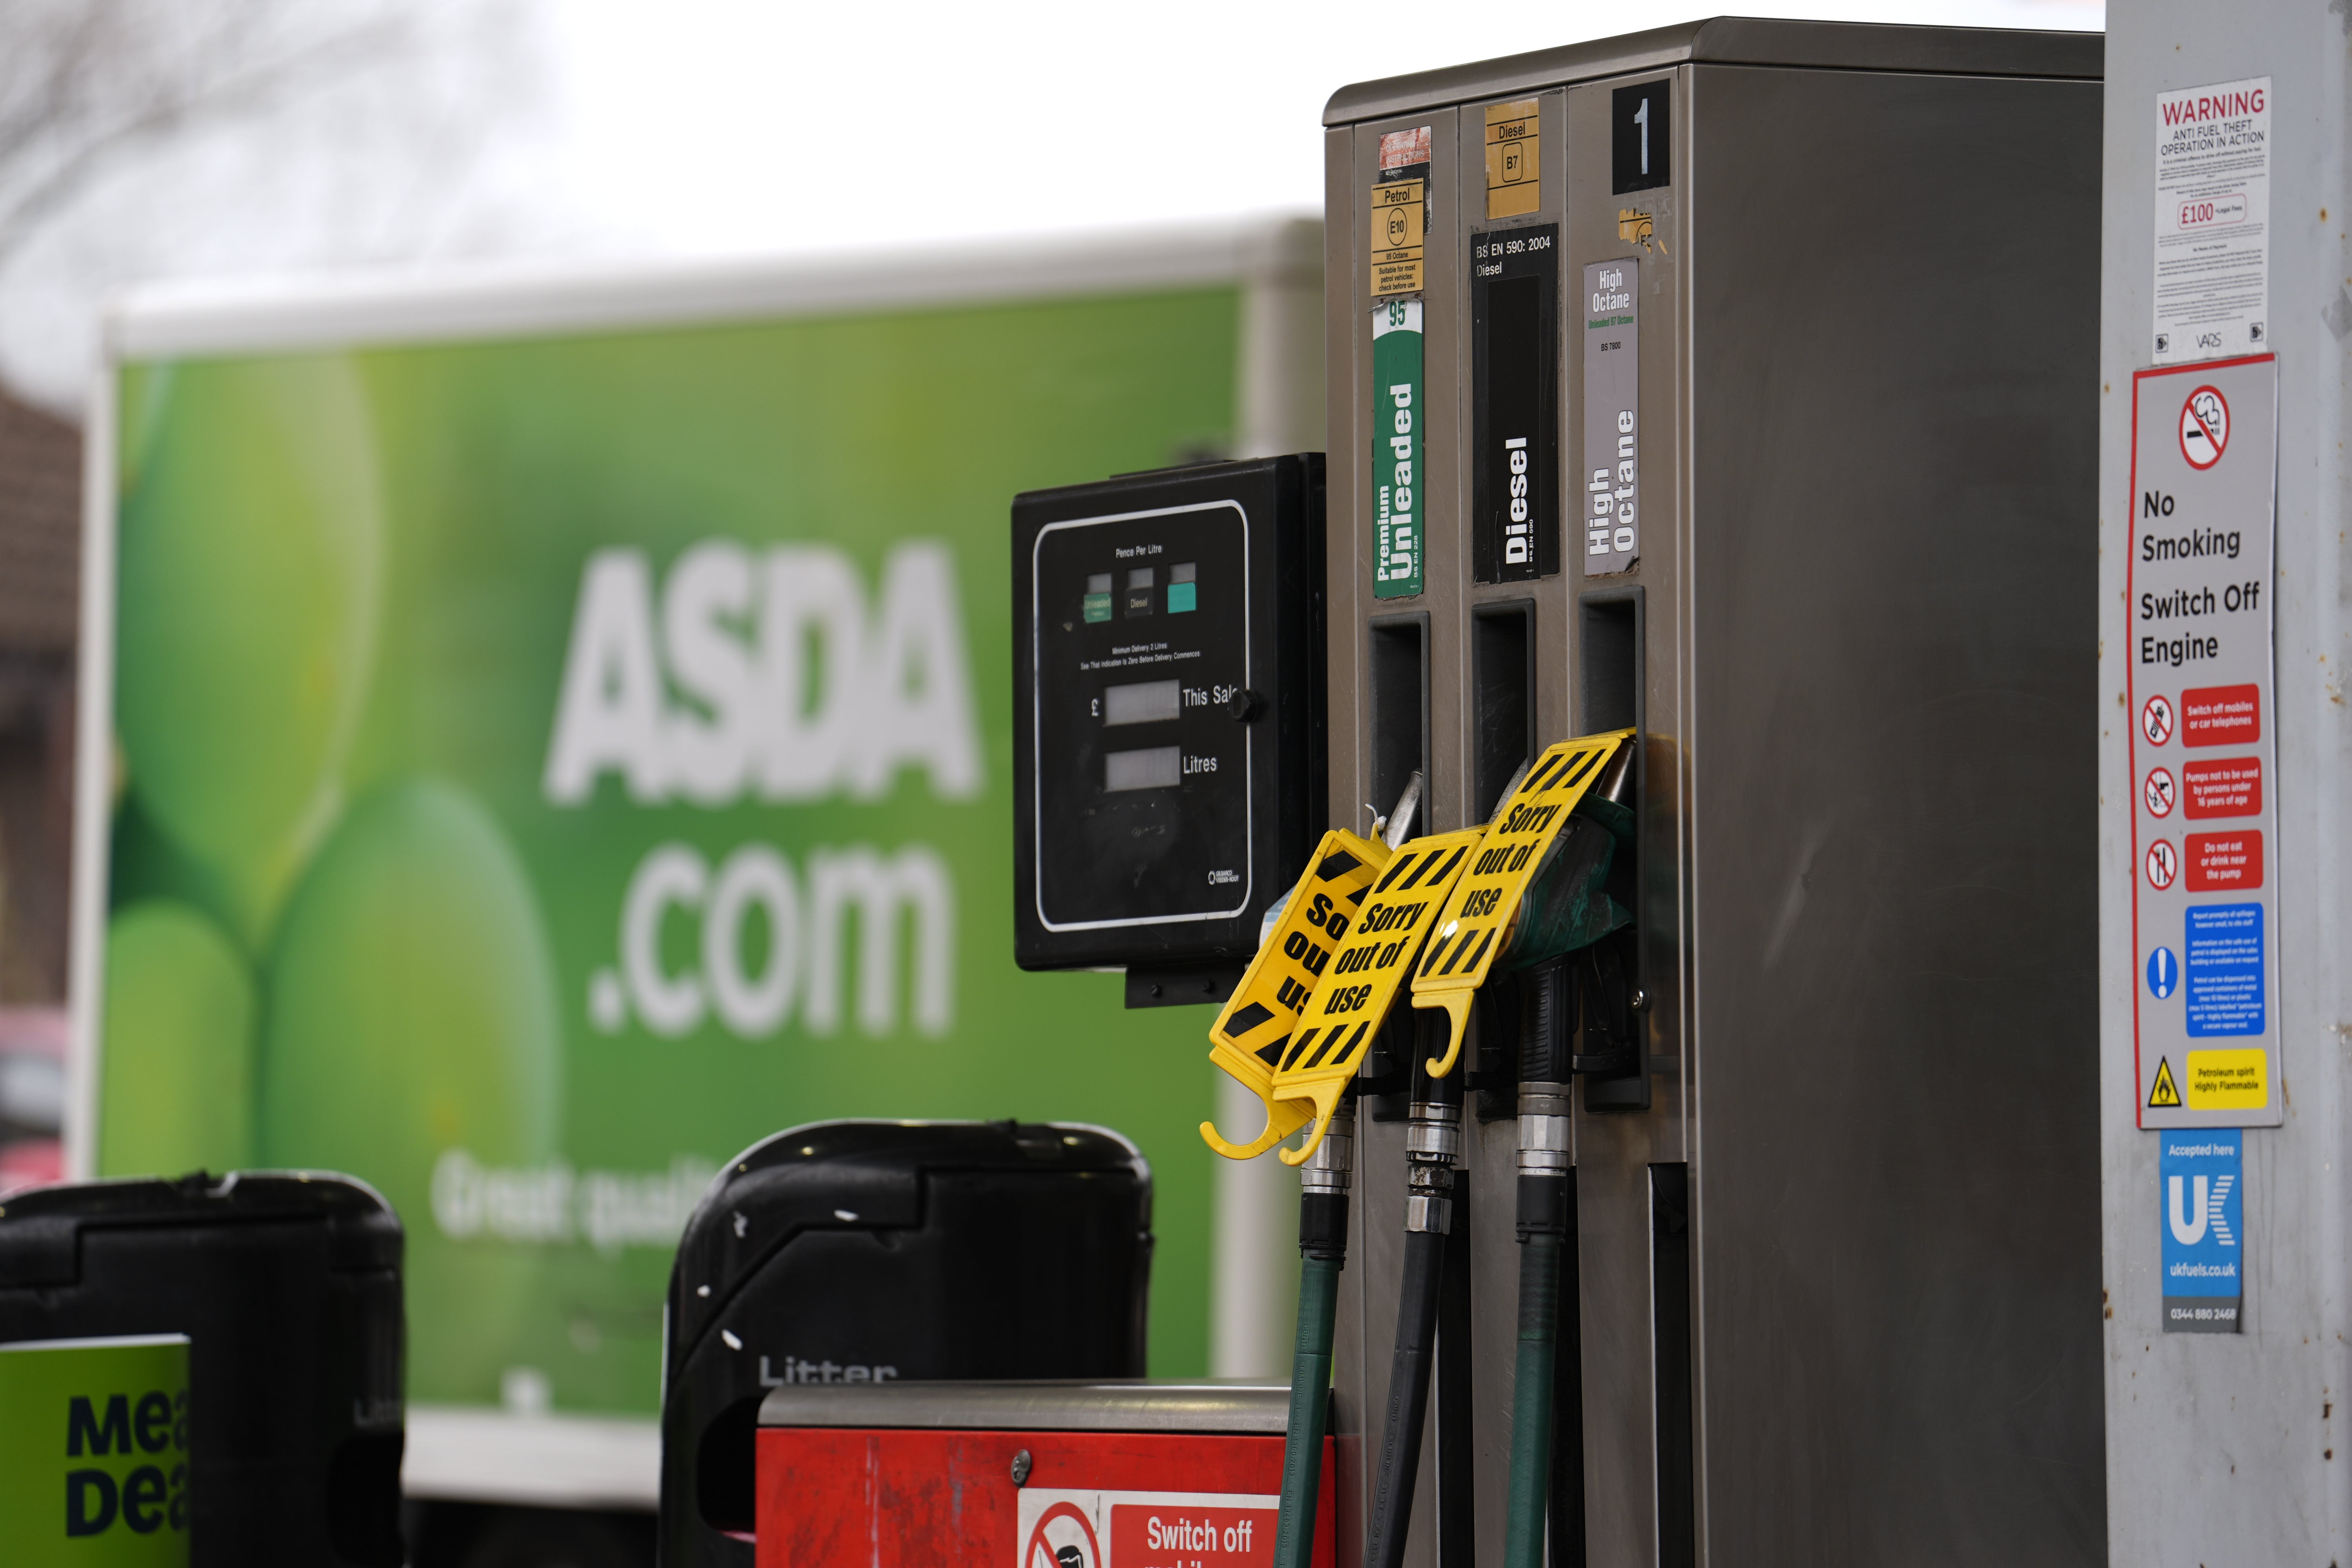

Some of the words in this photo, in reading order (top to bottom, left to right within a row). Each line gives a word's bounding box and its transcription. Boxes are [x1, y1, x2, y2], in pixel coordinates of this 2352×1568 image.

[2162, 88, 2264, 126] WARNING
[1499, 122, 1525, 140] Diesel
[1634, 98, 1648, 175] 1
[2173, 128, 2194, 141] ANTI
[2198, 124, 2220, 137] FUEL
[2223, 119, 2252, 133] THEFT
[2161, 138, 2213, 156] OPERATION
[2216, 136, 2225, 148] IN
[2229, 130, 2264, 146] ACTION
[1386, 150, 1424, 164] INSTRUCTIONS
[1507, 155, 1518, 170] B7
[1385, 187, 1410, 203] Petrol
[2182, 203, 2213, 224] £100
[1390, 220, 1404, 234] E10
[1477, 245, 1488, 258] BS
[1492, 243, 1503, 256] EN
[1506, 240, 1525, 254] 590:
[1528, 236, 1550, 251] 2004
[1379, 265, 1396, 274] Suitable
[1477, 261, 1502, 277] Diesel
[1379, 283, 1392, 292] check
[1381, 276, 1393, 284] petrol
[1599, 268, 1622, 292] High
[1593, 292, 1629, 313] Octane
[1389, 300, 1405, 326] 95
[1589, 317, 1610, 329] Unleaded
[1610, 316, 1616, 326] 97
[1617, 316, 1633, 325] Octane
[1609, 341, 1621, 350] 7800
[1390, 383, 1412, 580] Unleaded
[1613, 410, 1634, 553] Octane
[1505, 437, 1527, 564] Diesel
[2144, 491, 2174, 518] No
[1589, 468, 1614, 556] High
[1377, 485, 1389, 581] Premium
[1529, 536, 1534, 548] EN
[1116, 548, 1134, 558] Pence
[1136, 546, 1146, 556] Per
[1148, 544, 1161, 554] Litre
[2142, 527, 2240, 562] Smoking
[1414, 552, 1418, 564] EN
[1414, 566, 1418, 577] BS
[1085, 598, 1111, 609] Unleaded
[1131, 597, 1147, 608] Diesel
[2141, 586, 2215, 620] Switch
[2224, 581, 2260, 612] Off
[1131, 644, 1149, 653] Delivery
[2142, 633, 2218, 667] Engine
[1090, 661, 1100, 669] That
[1101, 659, 1121, 668] Indication
[1155, 653, 1172, 662] Delivery
[1173, 651, 1200, 660] Commences
[541, 535, 986, 808] ASDA
[1183, 688, 1207, 707] This
[1091, 699, 1099, 717] £
[2187, 703, 2212, 717] Switch
[2212, 702, 2224, 714] off
[2224, 701, 2253, 713] mobiles
[2189, 720, 2198, 730] or
[2199, 719, 2210, 729] car
[2212, 715, 2252, 728] telephones
[1183, 755, 1218, 774] Litres
[2186, 771, 2209, 784] Pumps
[2210, 771, 2221, 781] not
[2222, 770, 2230, 780] to
[2231, 769, 2240, 779] be
[2241, 768, 2259, 779] used
[2193, 785, 2202, 796] by
[2203, 784, 2230, 796] persons
[2231, 782, 2252, 792] under
[2198, 797, 2206, 807] 16
[2207, 796, 2225, 808] years
[2226, 795, 2234, 804] of
[2234, 795, 2248, 806] age
[1499, 803, 1563, 835] Sorry
[2205, 842, 2216, 853] Do
[2216, 842, 2229, 852] not
[2230, 841, 2243, 851] eat
[1473, 843, 1515, 876] out
[1508, 838, 1541, 872] of
[2200, 857, 2210, 867] or
[2210, 855, 2229, 867] drink
[2230, 855, 2247, 864] near
[2206, 869, 2219, 880] the
[2220, 869, 2241, 881] pump
[1460, 887, 1502, 918] use
[1358, 901, 1430, 935] Sorry
[589, 842, 956, 1039] .com
[1284, 931, 1330, 978] ou
[1335, 943, 1380, 975] out
[1376, 936, 1411, 968] of
[1324, 984, 1372, 1015] use
[2198, 1067, 2234, 1077] Petroleum
[2236, 1066, 2255, 1078] spirit
[2194, 1081, 2217, 1093] Highly
[2219, 1080, 2259, 1090] Flammable
[2169, 1143, 2212, 1158] Accepted
[2213, 1143, 2234, 1156] here
[2168, 1175, 2235, 1246] UK
[2170, 1262, 2236, 1277] ukfuels.co.uk
[2171, 1308, 2193, 1320] 0344
[2195, 1308, 2213, 1320] 880
[2214, 1308, 2236, 1320] 2468
[759, 1355, 897, 1387] Litter
[1296, 1360, 1305, 1398] SLIMLINE
[1295, 1402, 1301, 1410] 21
[65, 1389, 190, 1459] Mea
[1293, 1423, 1299, 1435] EN
[65, 1462, 190, 1539] Dea
[1286, 1490, 1292, 1502] EN
[1147, 1516, 1217, 1552] Switch
[1223, 1519, 1252, 1553] off
